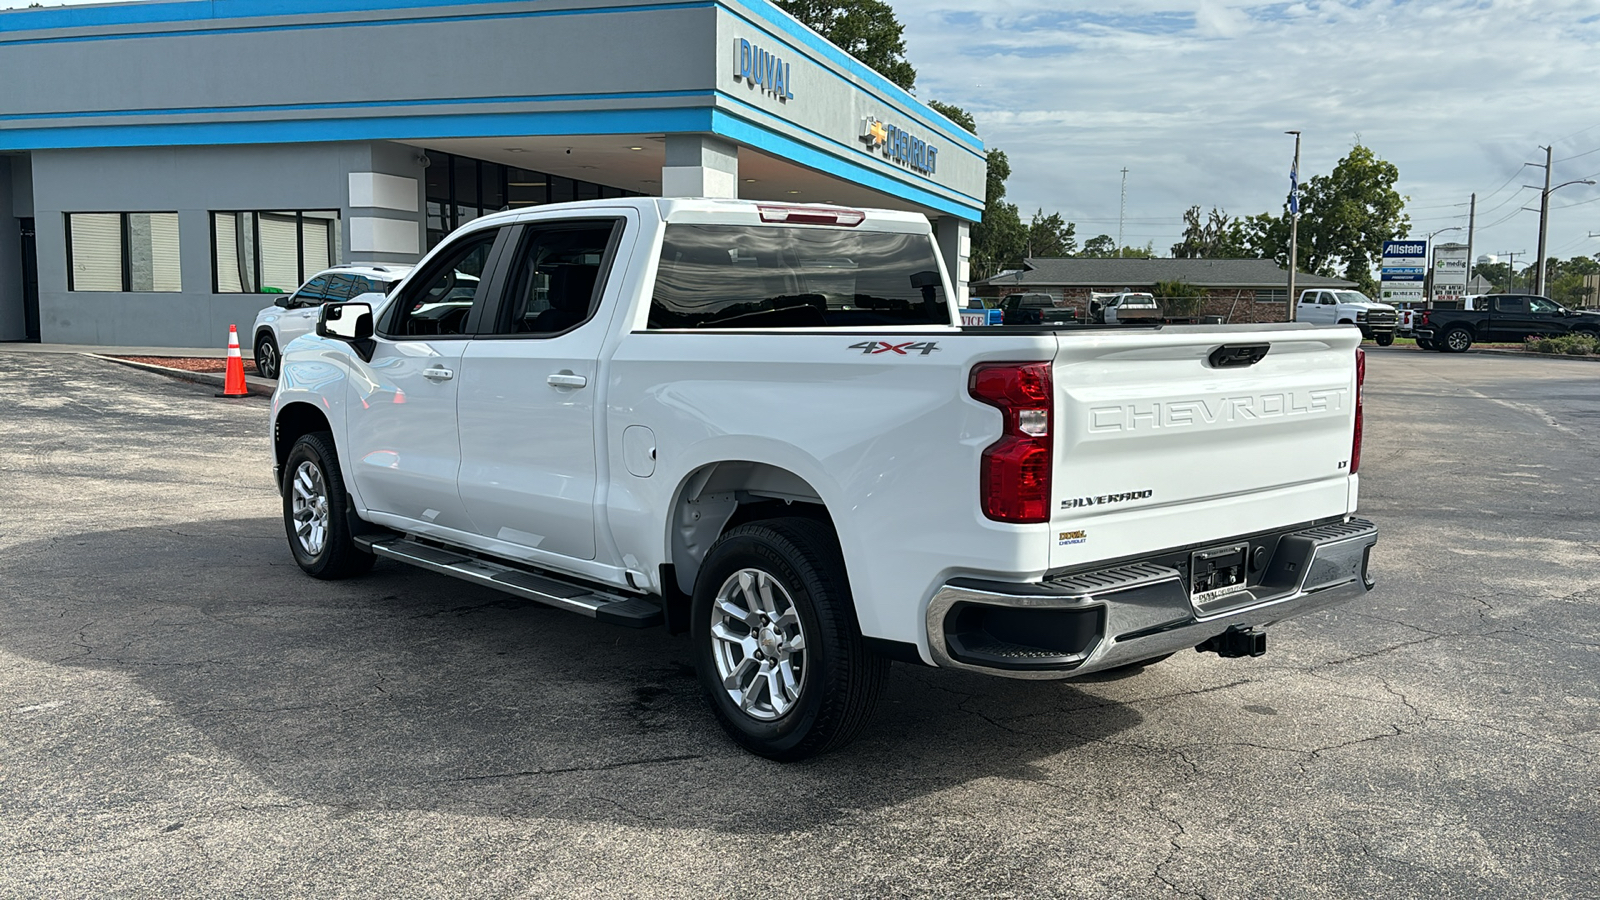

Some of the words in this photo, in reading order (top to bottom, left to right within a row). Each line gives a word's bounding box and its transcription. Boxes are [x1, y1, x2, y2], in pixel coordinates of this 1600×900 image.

[735, 38, 793, 100] DUVAL
[885, 124, 938, 174] CHEVROLET
[1384, 244, 1423, 255] Allstate
[961, 316, 984, 326] VICE
[1087, 387, 1348, 434] CHEVROLET
[1338, 460, 1348, 469] LT
[1060, 489, 1153, 510] SILVERADO
[1059, 530, 1087, 541] DUVAL
[757, 545, 805, 593] MICHELIN
